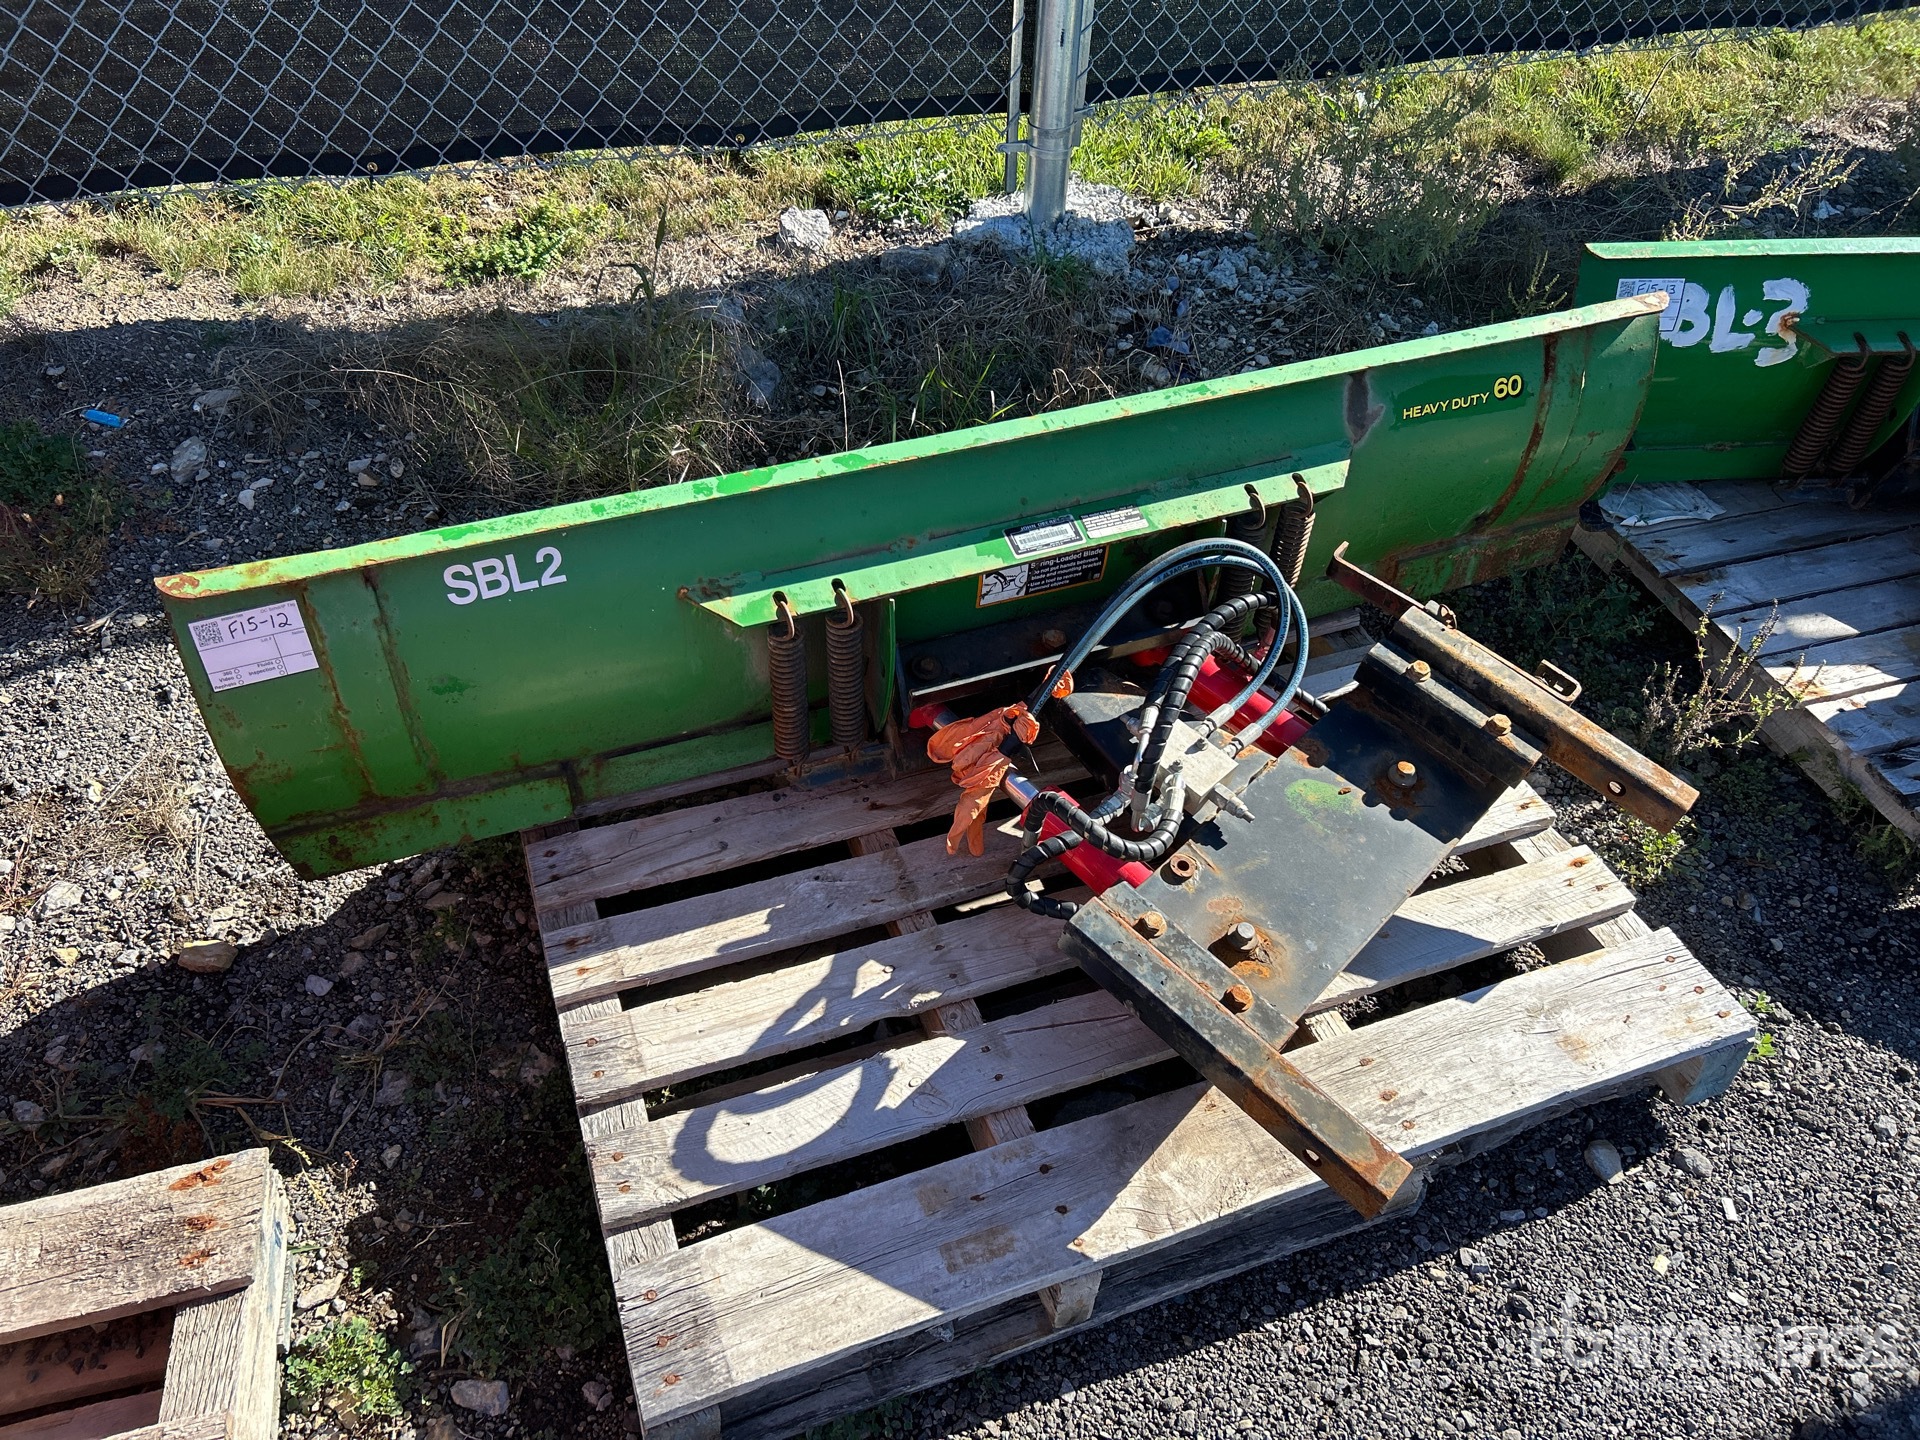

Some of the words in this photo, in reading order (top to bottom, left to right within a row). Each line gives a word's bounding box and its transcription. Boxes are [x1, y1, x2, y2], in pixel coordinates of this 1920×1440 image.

[1402, 399, 1449, 420] HEAVY
[1451, 391, 1491, 410] DUTY
[1493, 374, 1523, 399] 60
[1020, 524, 1037, 532] JOHN
[1031, 552, 1082, 569] Sring-Loaded
[1083, 548, 1103, 557] Blade
[1077, 556, 1099, 566] between
[443, 546, 567, 605] SBL2
[1058, 565, 1082, 574] mounting
[228, 612, 292, 639] F15-12
[248, 666, 277, 676] Inspection
